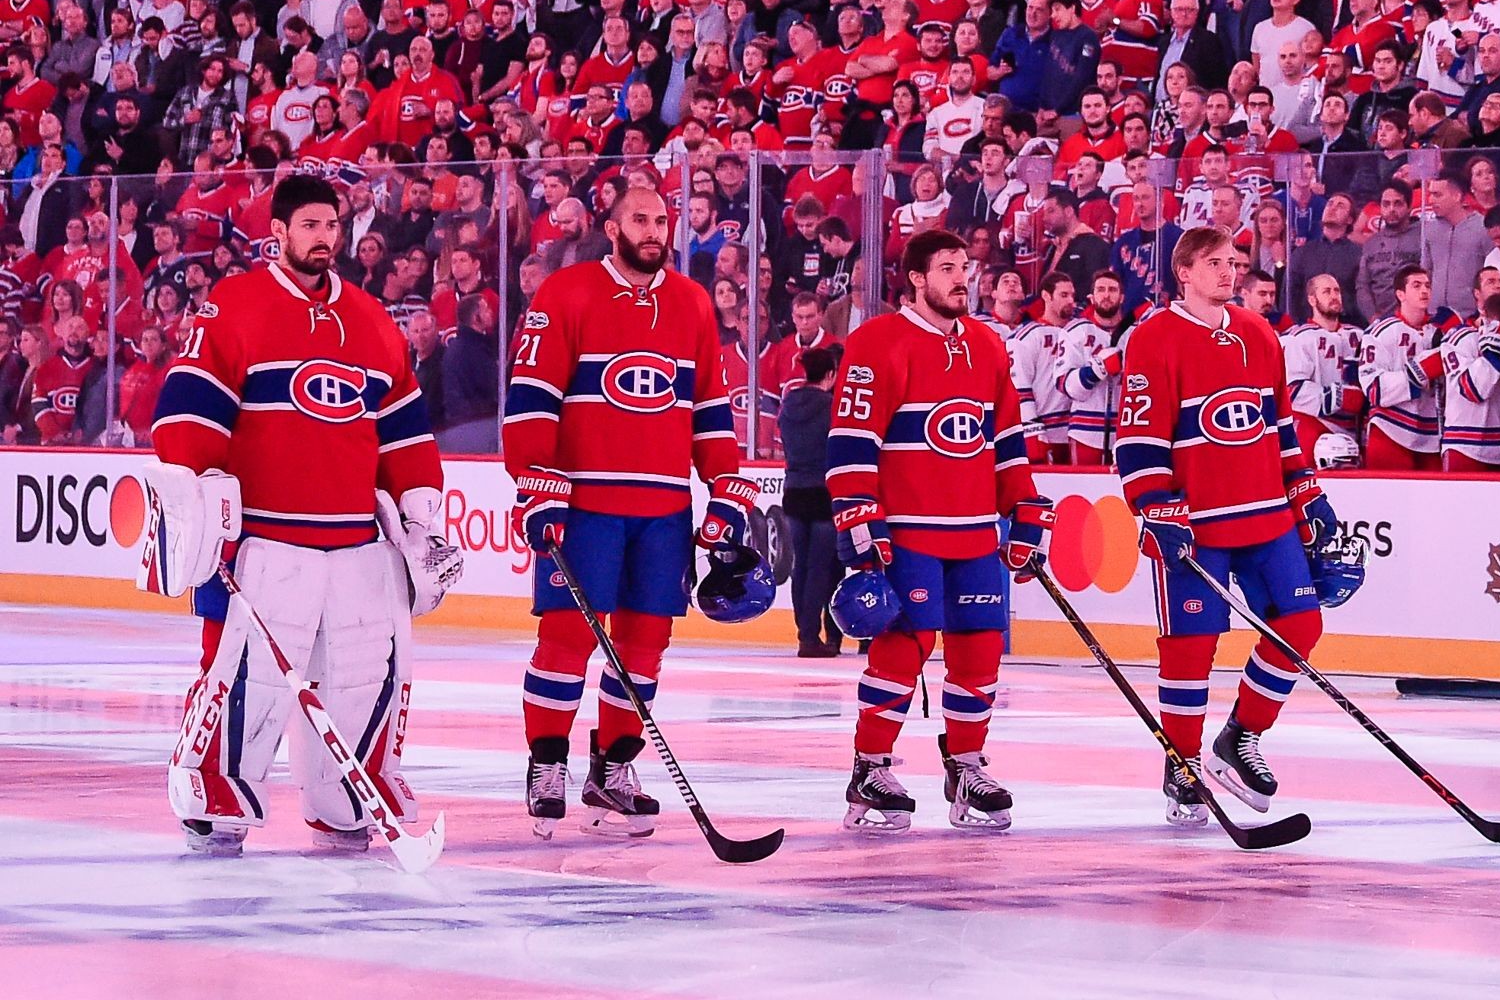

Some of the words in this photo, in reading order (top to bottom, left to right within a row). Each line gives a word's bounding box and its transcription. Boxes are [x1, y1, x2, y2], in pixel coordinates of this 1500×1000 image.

[514, 334, 540, 366] 21
[838, 386, 874, 420] 65
[1120, 395, 1152, 427] 62
[445, 489, 532, 575] Roug
[834, 502, 878, 527] CCM
[958, 594, 1002, 604] CCM
[191, 681, 230, 757] CCM
[388, 682, 412, 758] CCM
[1153, 729, 1197, 784] CCM
[324, 730, 402, 843] CCM
